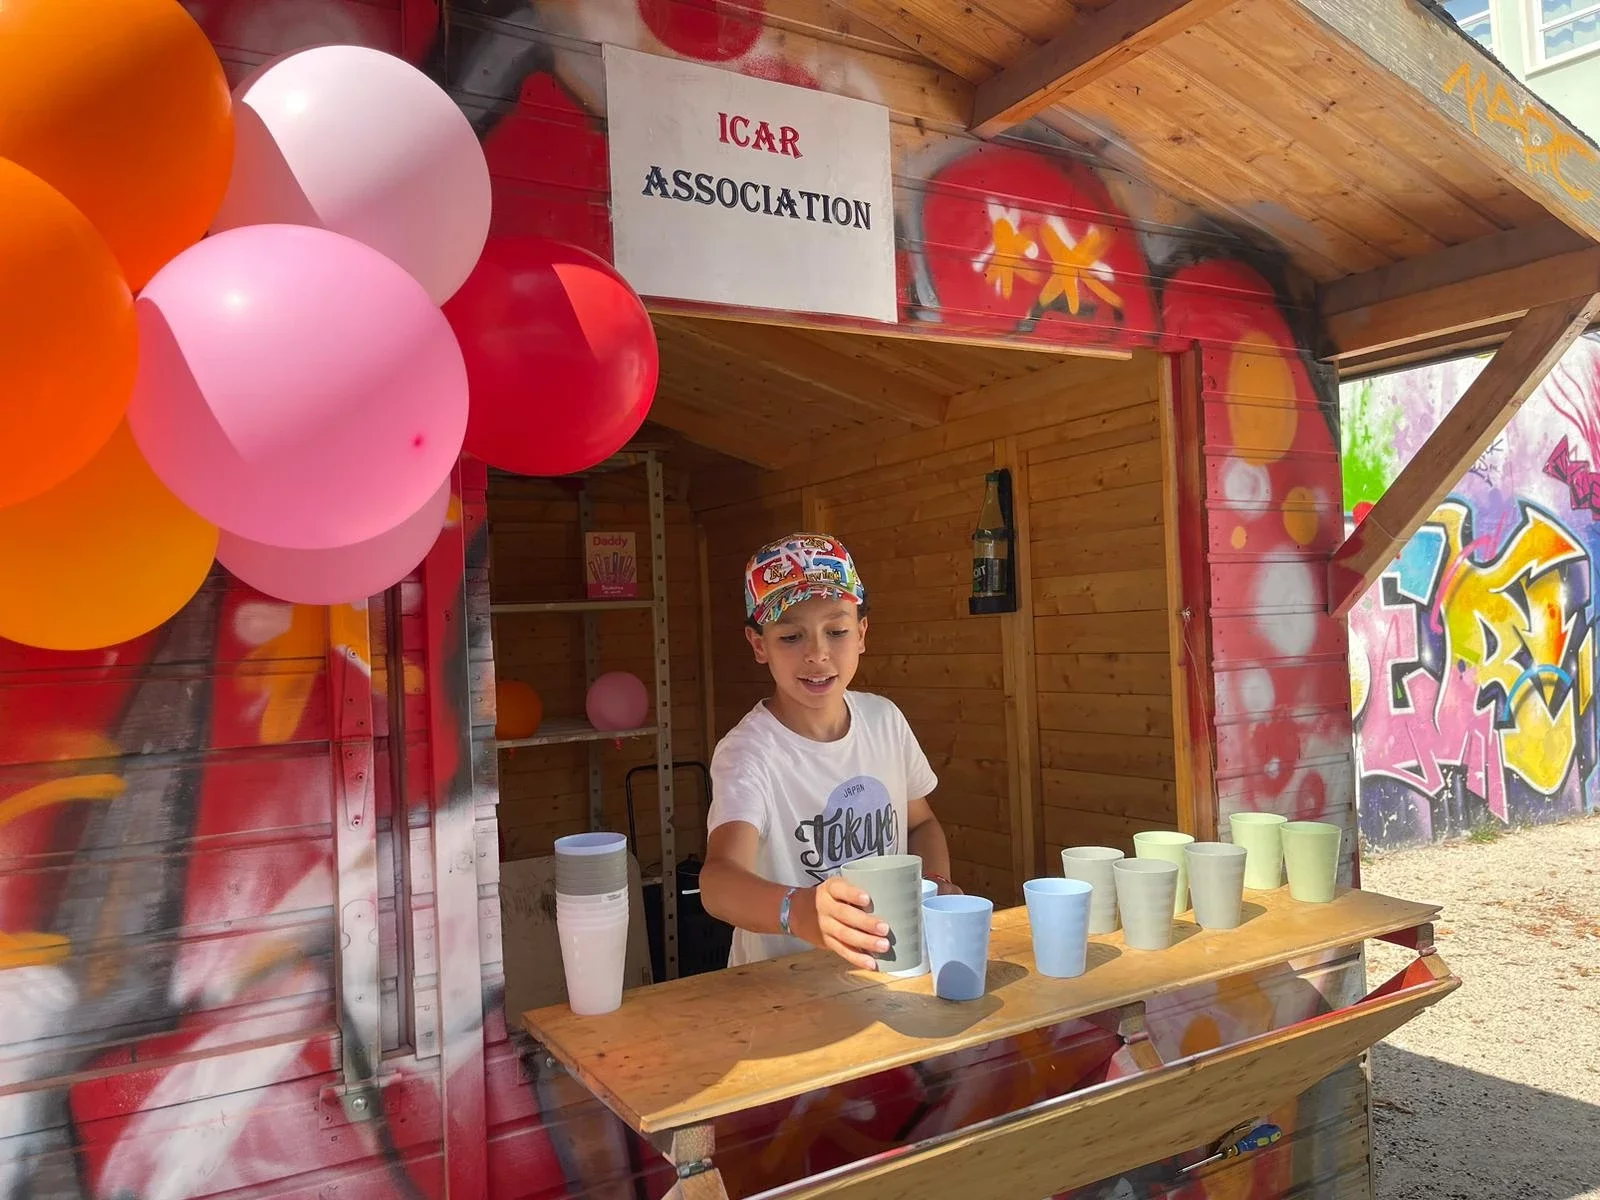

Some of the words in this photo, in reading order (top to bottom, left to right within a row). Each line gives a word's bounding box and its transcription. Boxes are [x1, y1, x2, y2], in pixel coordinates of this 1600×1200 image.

[718, 112, 803, 159] ICAR
[641, 166, 872, 230] ASSOCIATION
[592, 536, 629, 549] Daddy
[843, 783, 865, 798] JAPAN
[795, 803, 897, 868] Tokyo
